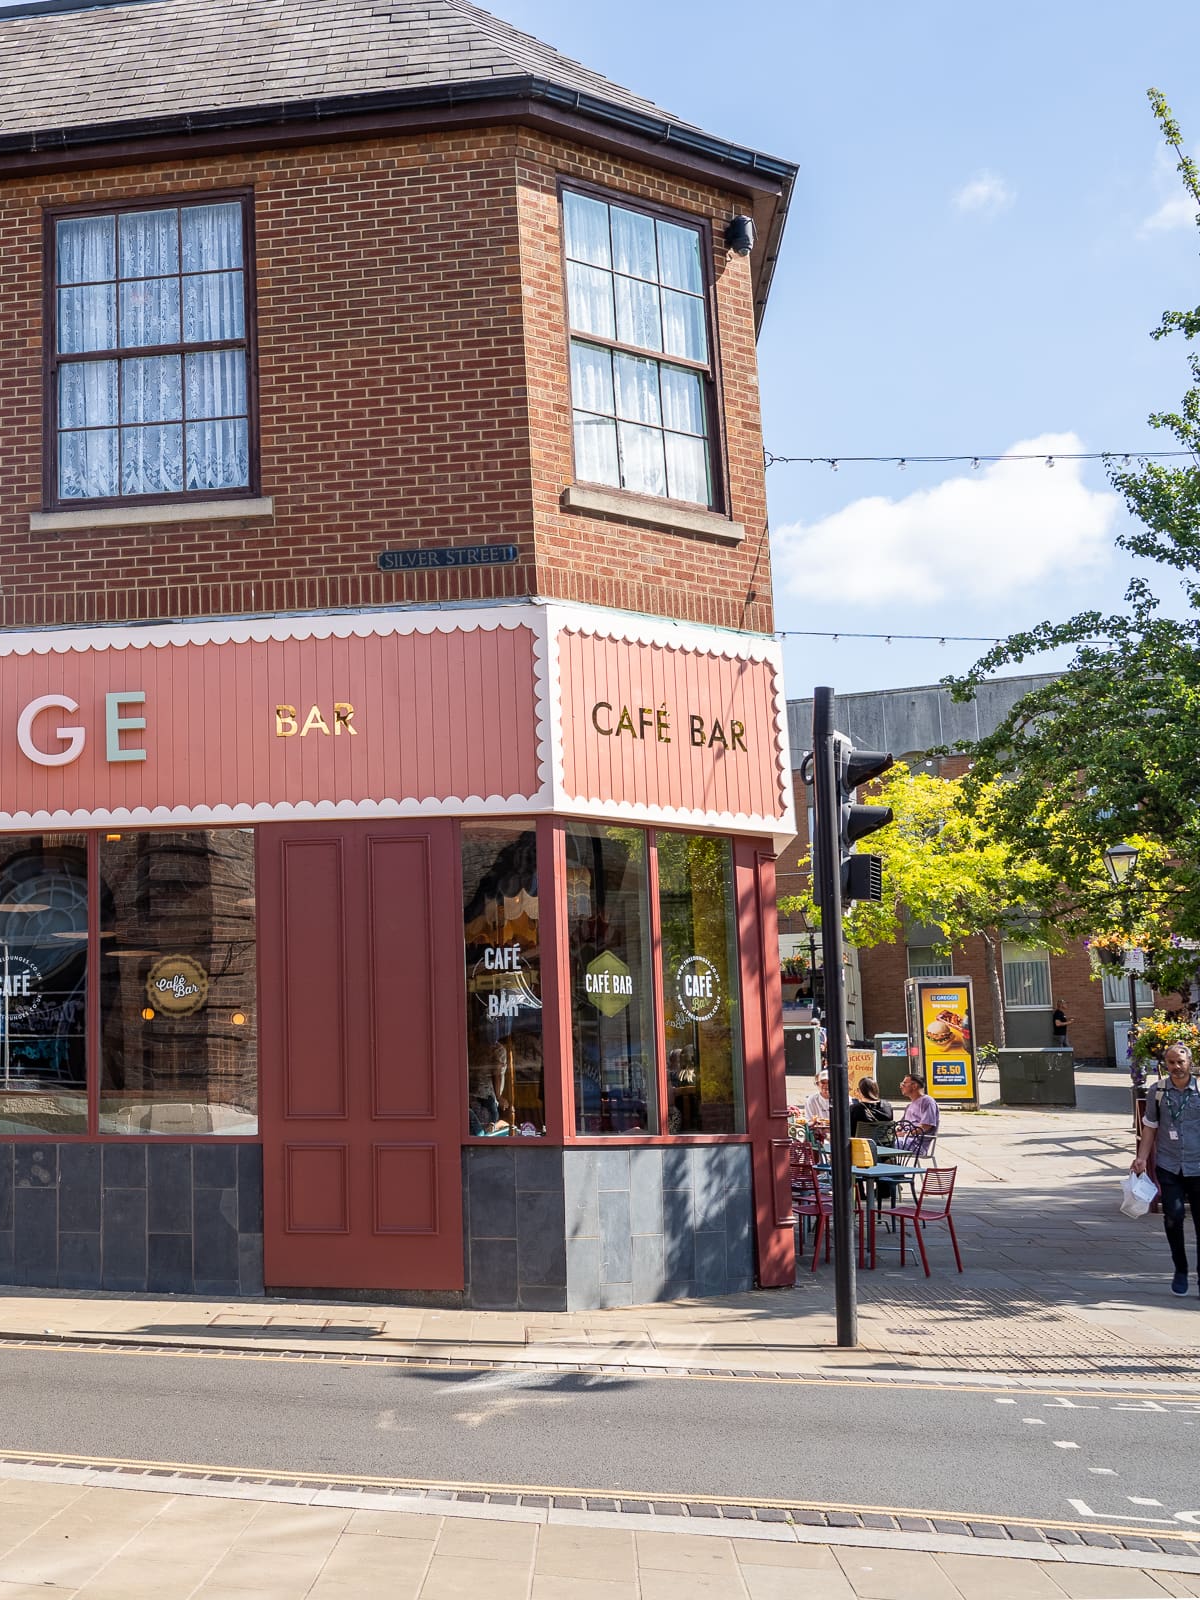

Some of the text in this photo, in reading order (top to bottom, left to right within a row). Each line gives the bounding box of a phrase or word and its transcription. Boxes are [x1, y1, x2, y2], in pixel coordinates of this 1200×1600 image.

[385, 546, 511, 568] SILVER STREET
[276, 702, 358, 737] BAR
[591, 701, 747, 752] CAFÉ BAR
[484, 943, 521, 970] CAFÉ
[155, 974, 187, 992] Café
[174, 984, 200, 998] Bar
[585, 969, 633, 995] CAFÉ BAR
[684, 970, 713, 998] CAFÉ
[488, 994, 519, 1016] BAR
[936, 1065, 961, 1075] £5.50
